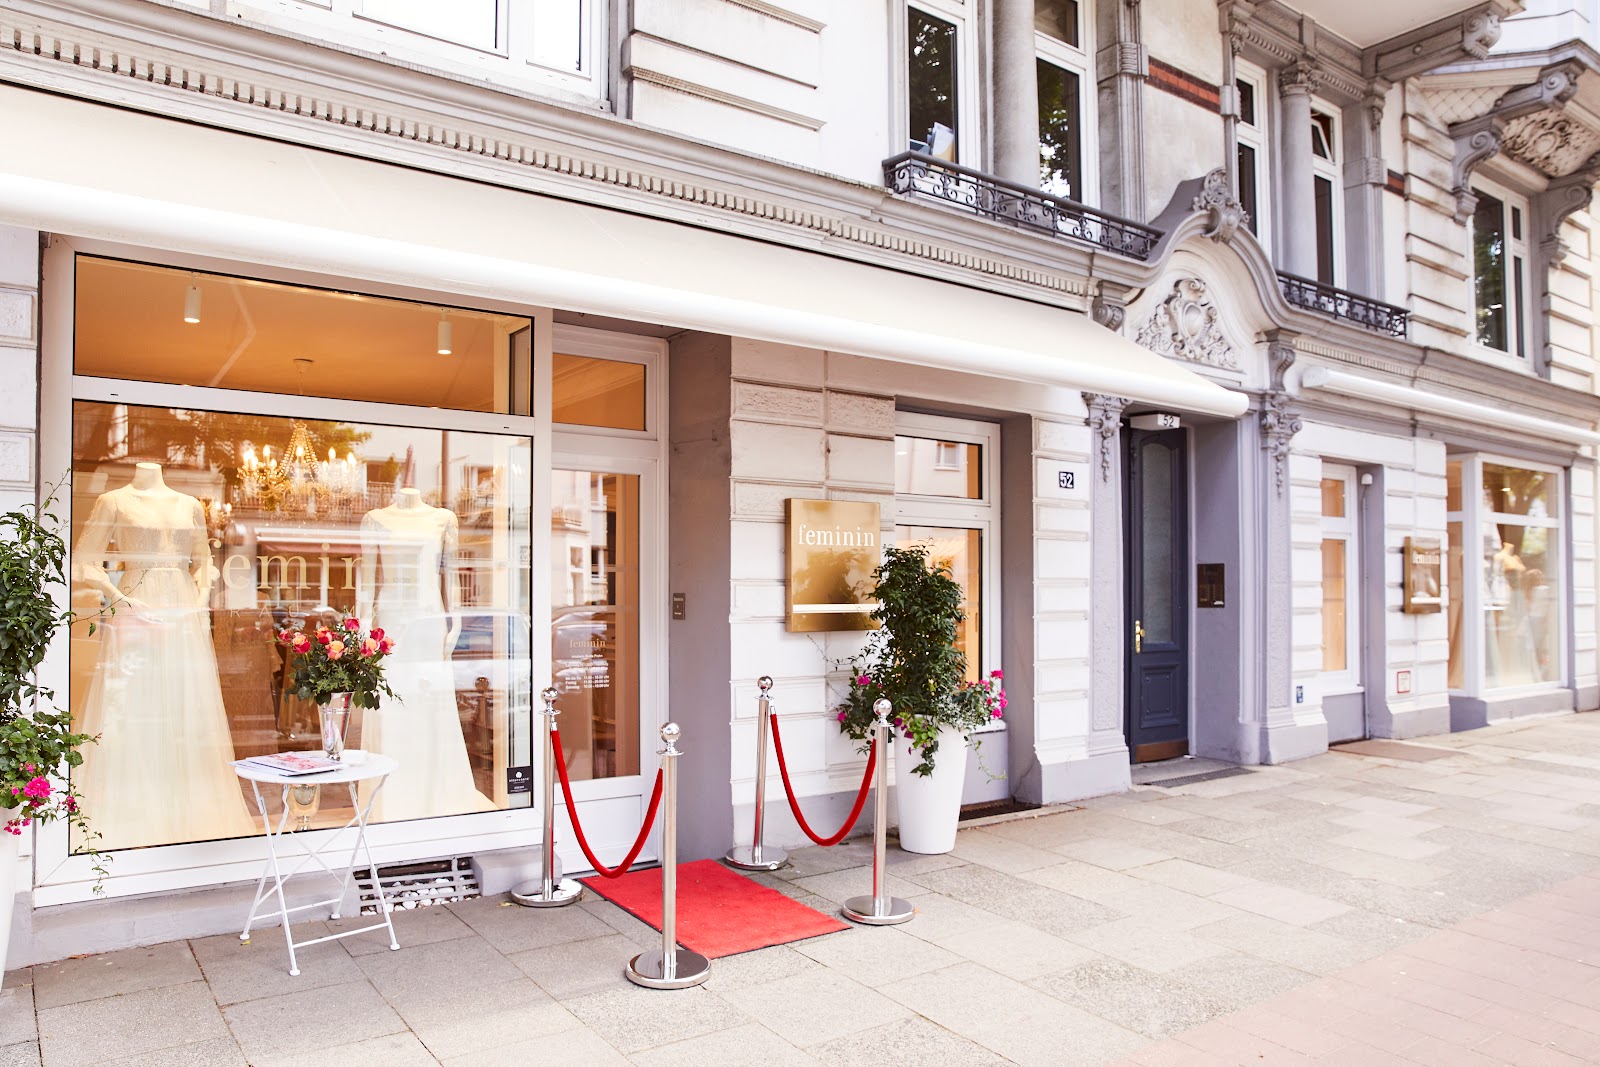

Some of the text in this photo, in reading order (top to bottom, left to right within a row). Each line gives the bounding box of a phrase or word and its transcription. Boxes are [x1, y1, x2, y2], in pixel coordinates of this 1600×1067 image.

[1163, 415, 1175, 428] 52
[1060, 472, 1073, 488] 52
[798, 523, 876, 547] feminin
[569, 638, 606, 648] feminin
